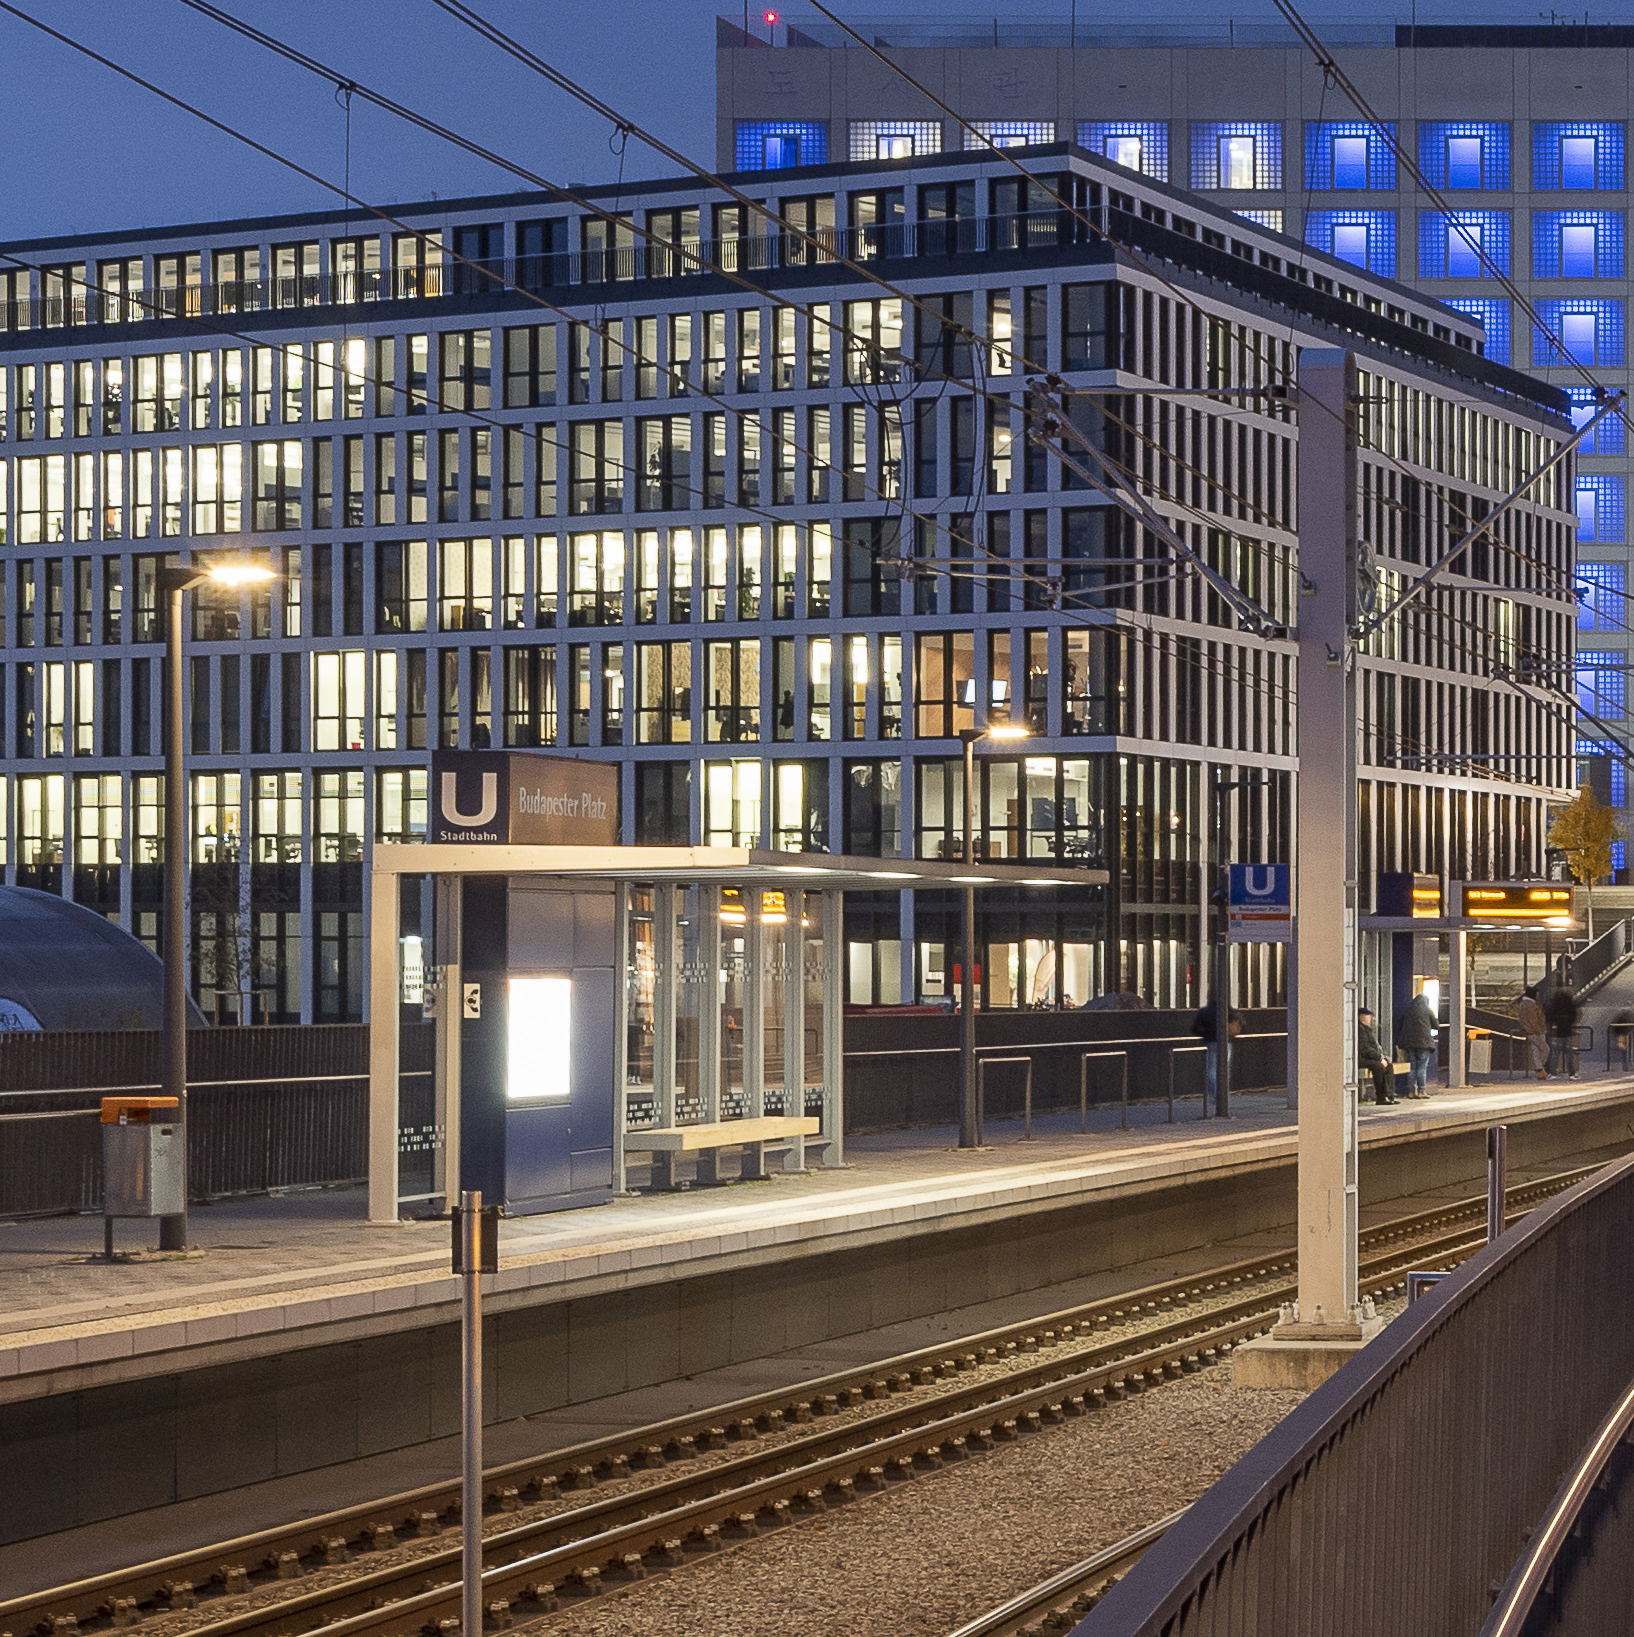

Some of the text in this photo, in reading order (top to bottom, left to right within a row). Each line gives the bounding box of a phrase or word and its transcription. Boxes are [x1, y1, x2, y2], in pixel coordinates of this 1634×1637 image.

[441, 772, 498, 827] U
[519, 786, 607, 823] Budapester Platz
[440, 830, 498, 842] Stadtbahn
[1245, 866, 1274, 895] U
